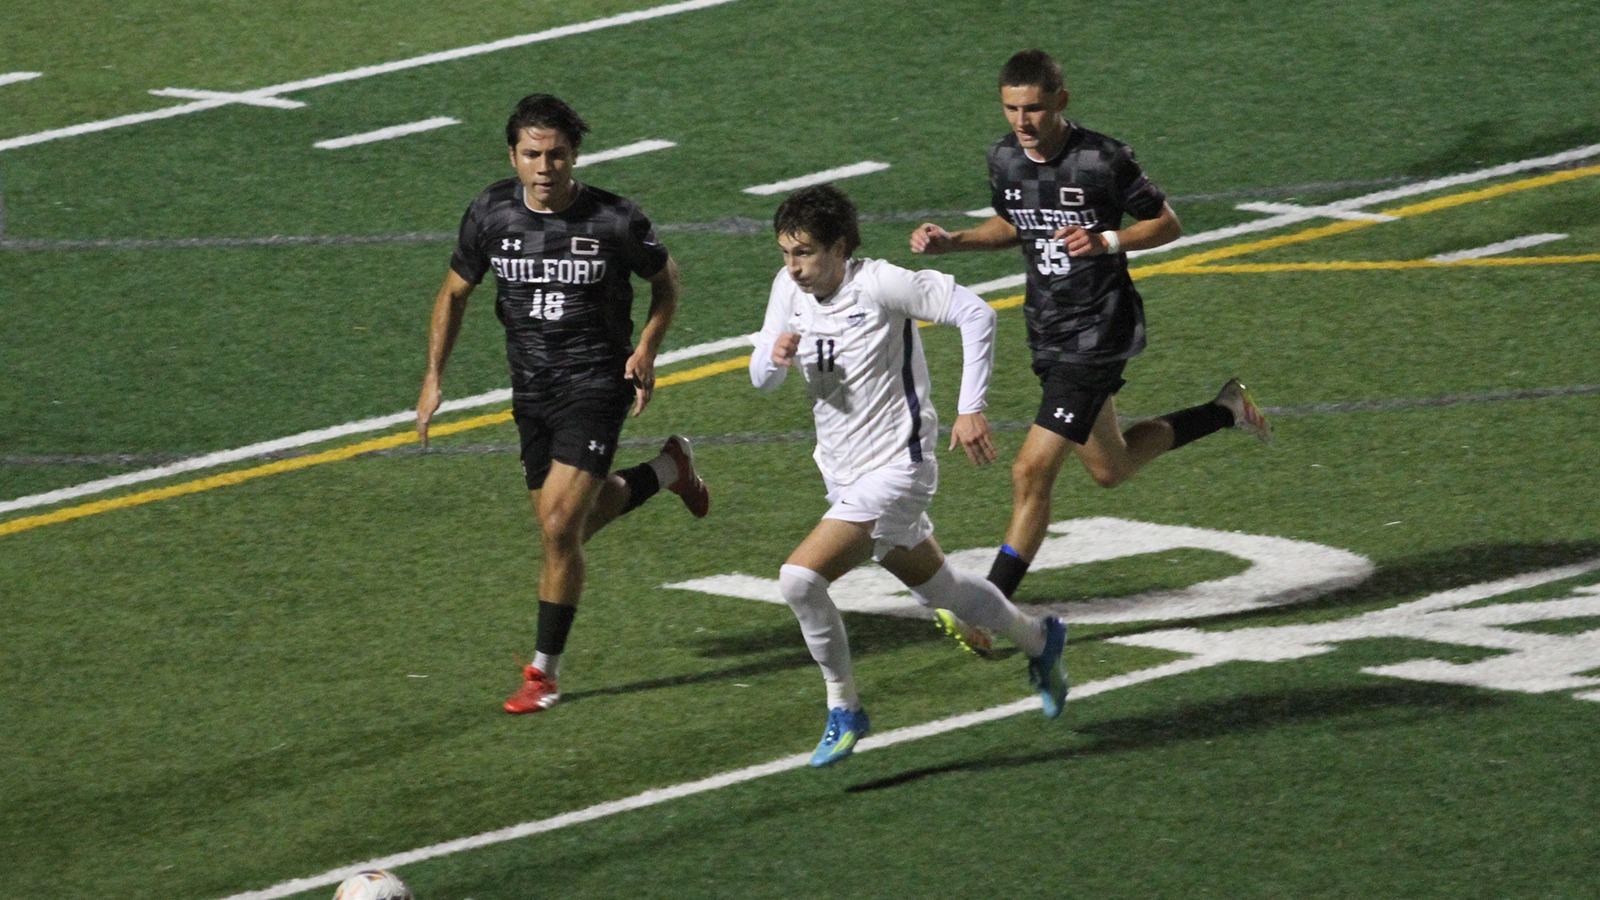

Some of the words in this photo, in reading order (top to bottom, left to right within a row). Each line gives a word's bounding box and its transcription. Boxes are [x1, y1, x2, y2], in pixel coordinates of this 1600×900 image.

[1059, 186, 1085, 207] G
[1006, 208, 1099, 231] UILFORD
[570, 236, 600, 256] G
[1034, 238, 1071, 276] 35
[490, 257, 606, 284] GUILFORD
[528, 288, 566, 321] 18
[815, 339, 835, 373] 11
